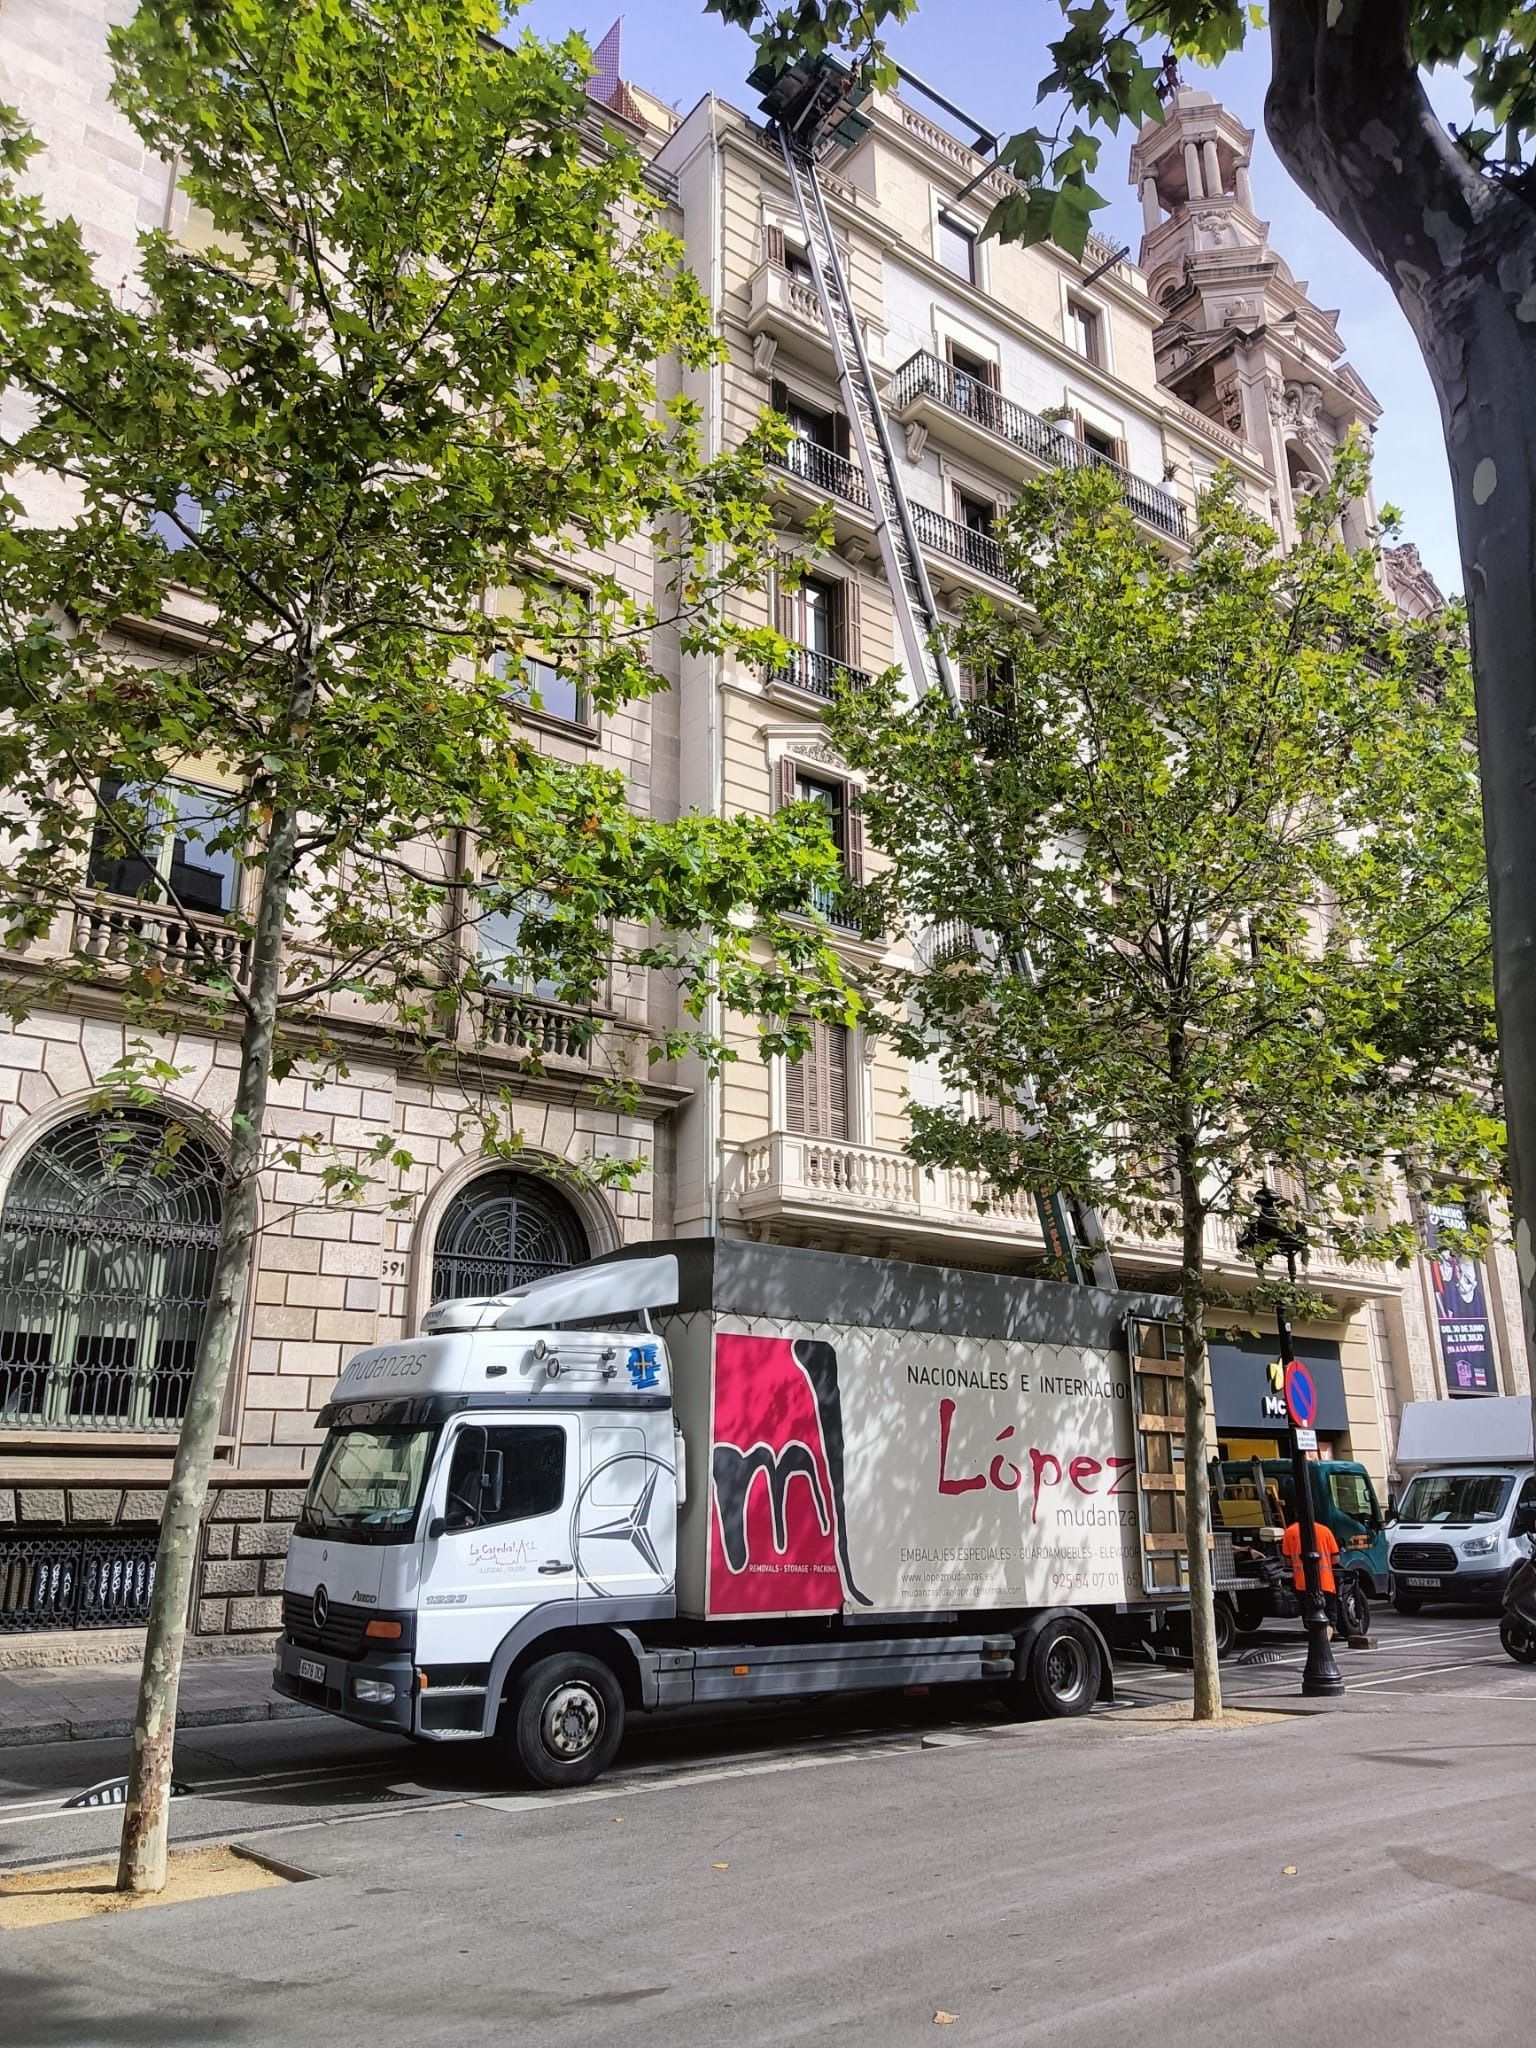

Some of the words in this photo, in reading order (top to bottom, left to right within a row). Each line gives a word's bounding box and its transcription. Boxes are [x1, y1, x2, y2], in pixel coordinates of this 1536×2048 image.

[382, 1260, 405, 1277] 591
[343, 1351, 427, 1383] mudanzas
[907, 1365, 1008, 1390] NACIONALES
[1020, 1374, 1029, 1392] E
[939, 1398, 1136, 1524] López
[900, 1547, 956, 1561] EMBALAJES
[959, 1546, 1012, 1561] ESPECIALES
[1020, 1546, 1092, 1560] GUARDAMUEBLES
[749, 1564, 779, 1573] REMOVALS
[784, 1564, 808, 1573] STORAGE
[813, 1564, 837, 1573] PACKING
[1052, 1573, 1073, 1590] 925
[1075, 1573, 1089, 1589] 54
[1092, 1573, 1105, 1588] 07
[1108, 1572, 1119, 1587] 01
